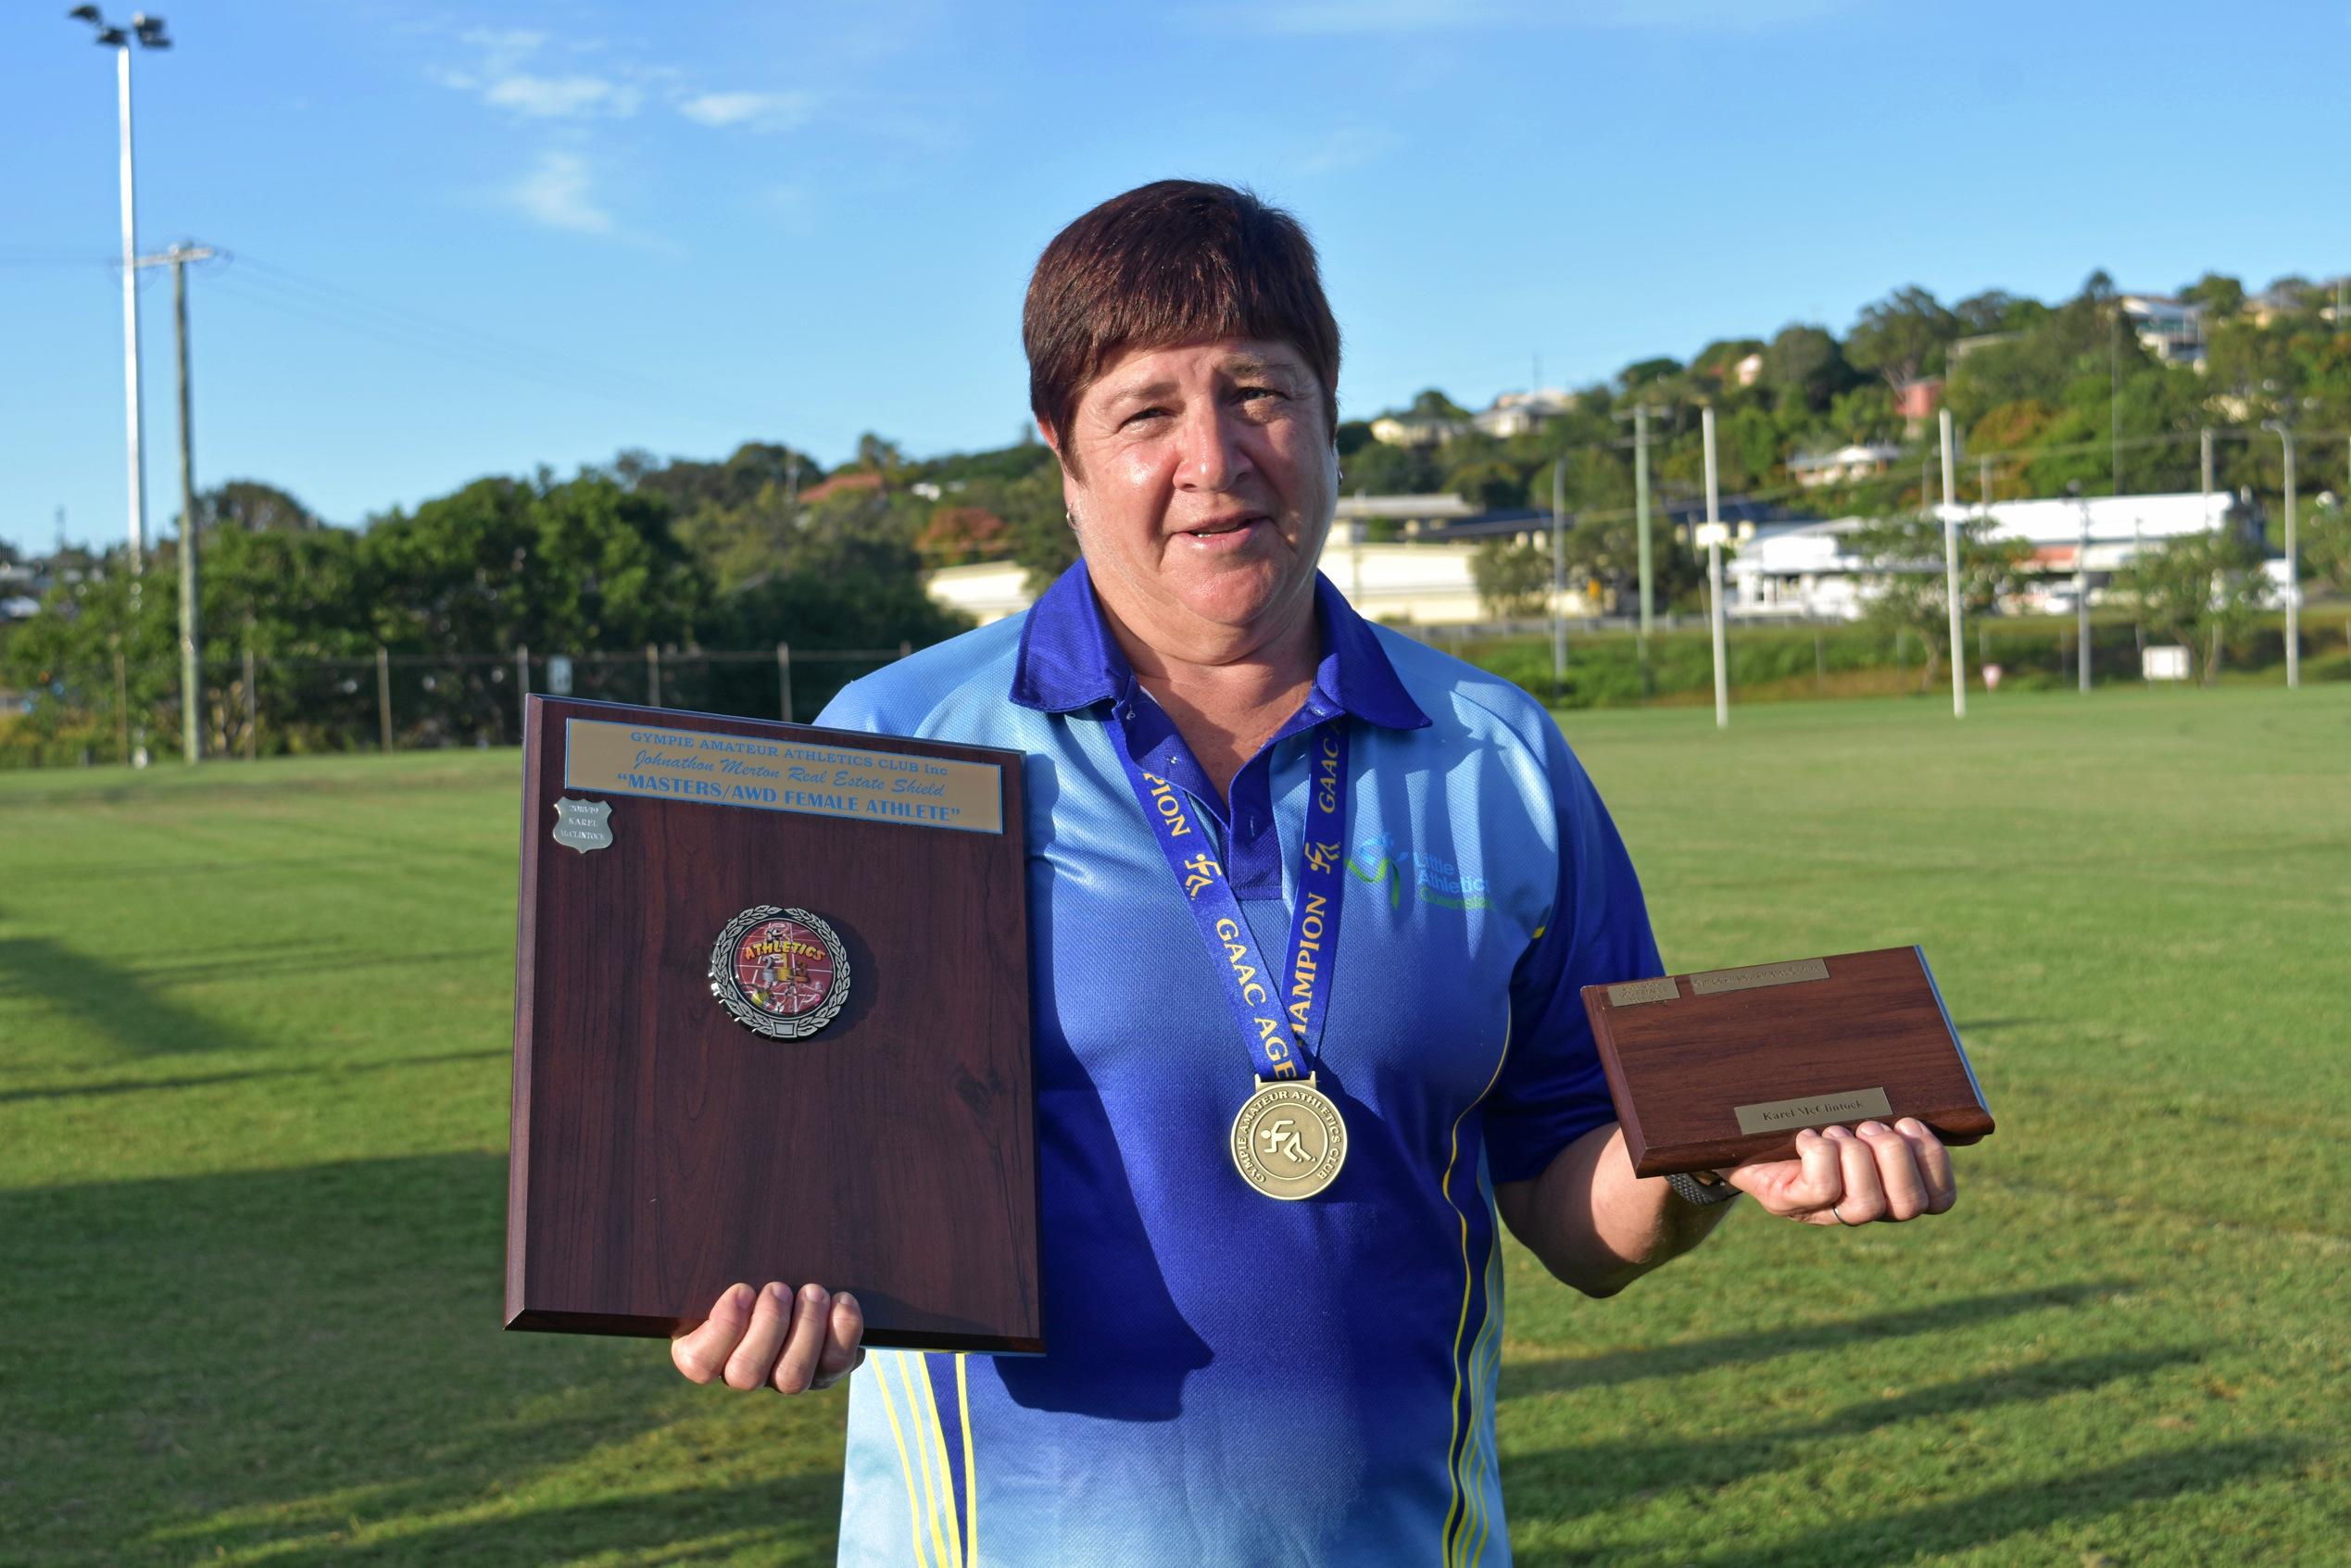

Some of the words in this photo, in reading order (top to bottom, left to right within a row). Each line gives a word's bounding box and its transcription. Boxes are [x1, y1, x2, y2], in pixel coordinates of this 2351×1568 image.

[631, 732, 694, 748] GYMPIE
[699, 739, 778, 758] AMATEUR
[784, 748, 874, 768] ATHLETICS
[877, 759, 920, 772] CLUB
[924, 764, 949, 776] Inc
[634, 750, 715, 771] Johnathon
[720, 759, 781, 778] Merton
[788, 766, 827, 784] Real
[833, 771, 885, 790] Estate
[891, 779, 946, 797] Shield
[1318, 737, 1339, 813] GAAC
[785, 790, 859, 812] FEMALE
[745, 940, 825, 961] ATHLETICS
[1216, 918, 1266, 1007] GAAC
[1254, 1018, 1297, 1080] AGE
[1239, 1090, 1289, 1135] AMATEUR
[1291, 1091, 1341, 1144] ATHLETICS
[1763, 1110, 1794, 1122] Karel
[1238, 1136, 1266, 1183] GYMPIE
[1317, 1148, 1340, 1180] CLUB
